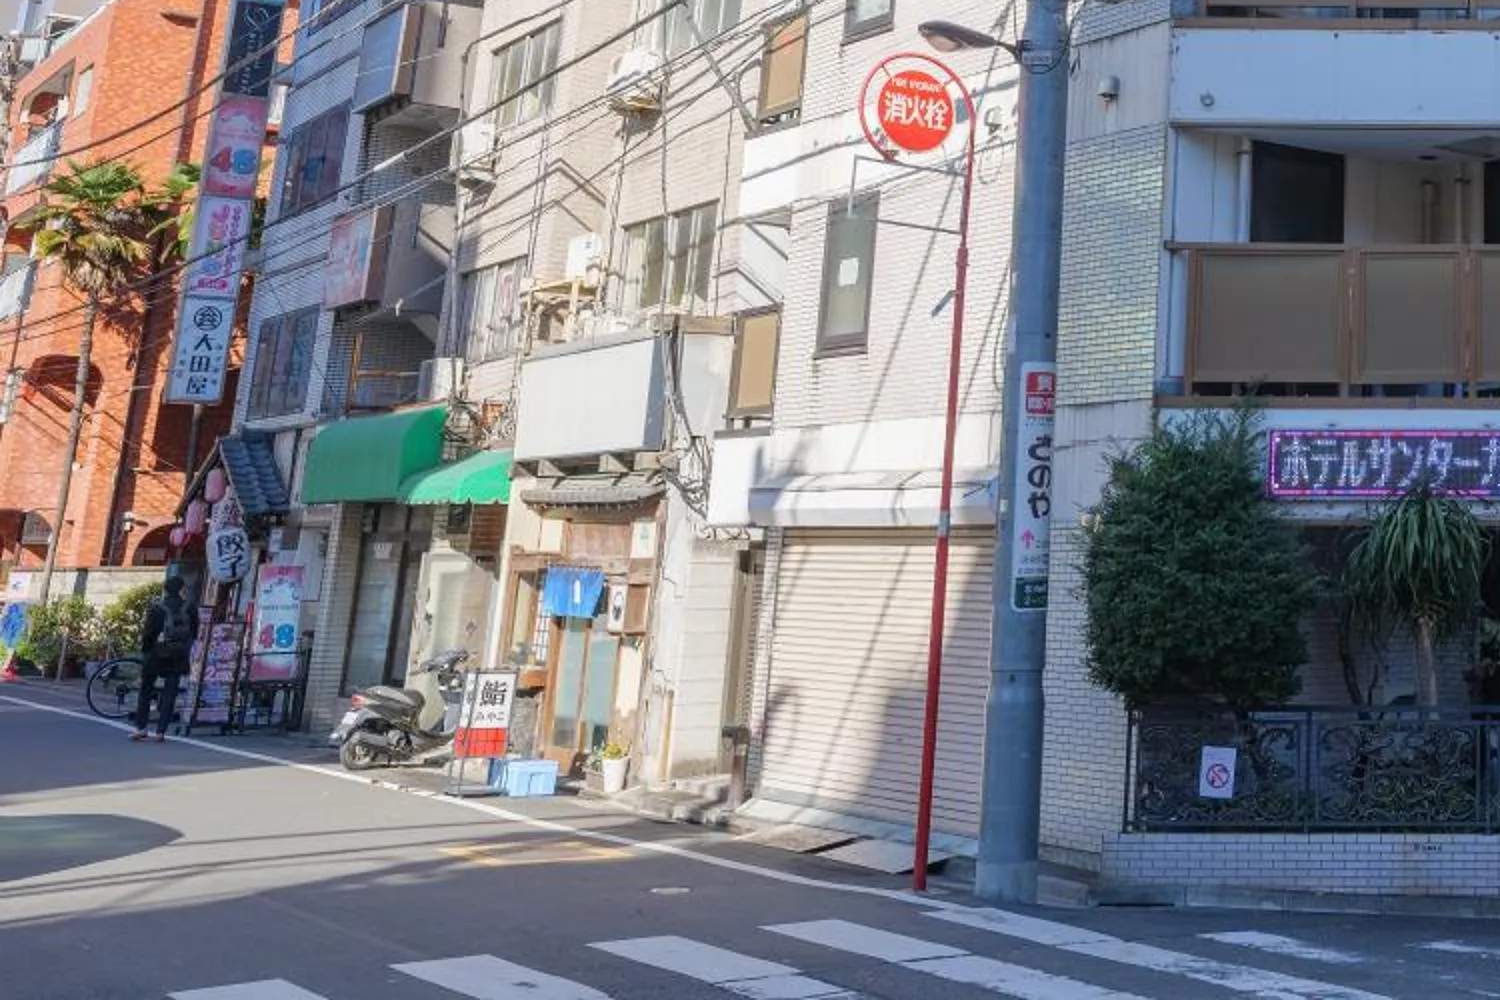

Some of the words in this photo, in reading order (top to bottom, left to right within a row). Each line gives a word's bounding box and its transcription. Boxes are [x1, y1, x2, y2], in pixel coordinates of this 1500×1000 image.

[884, 91, 950, 131] 消火栓
[260, 624, 295, 649] 48
